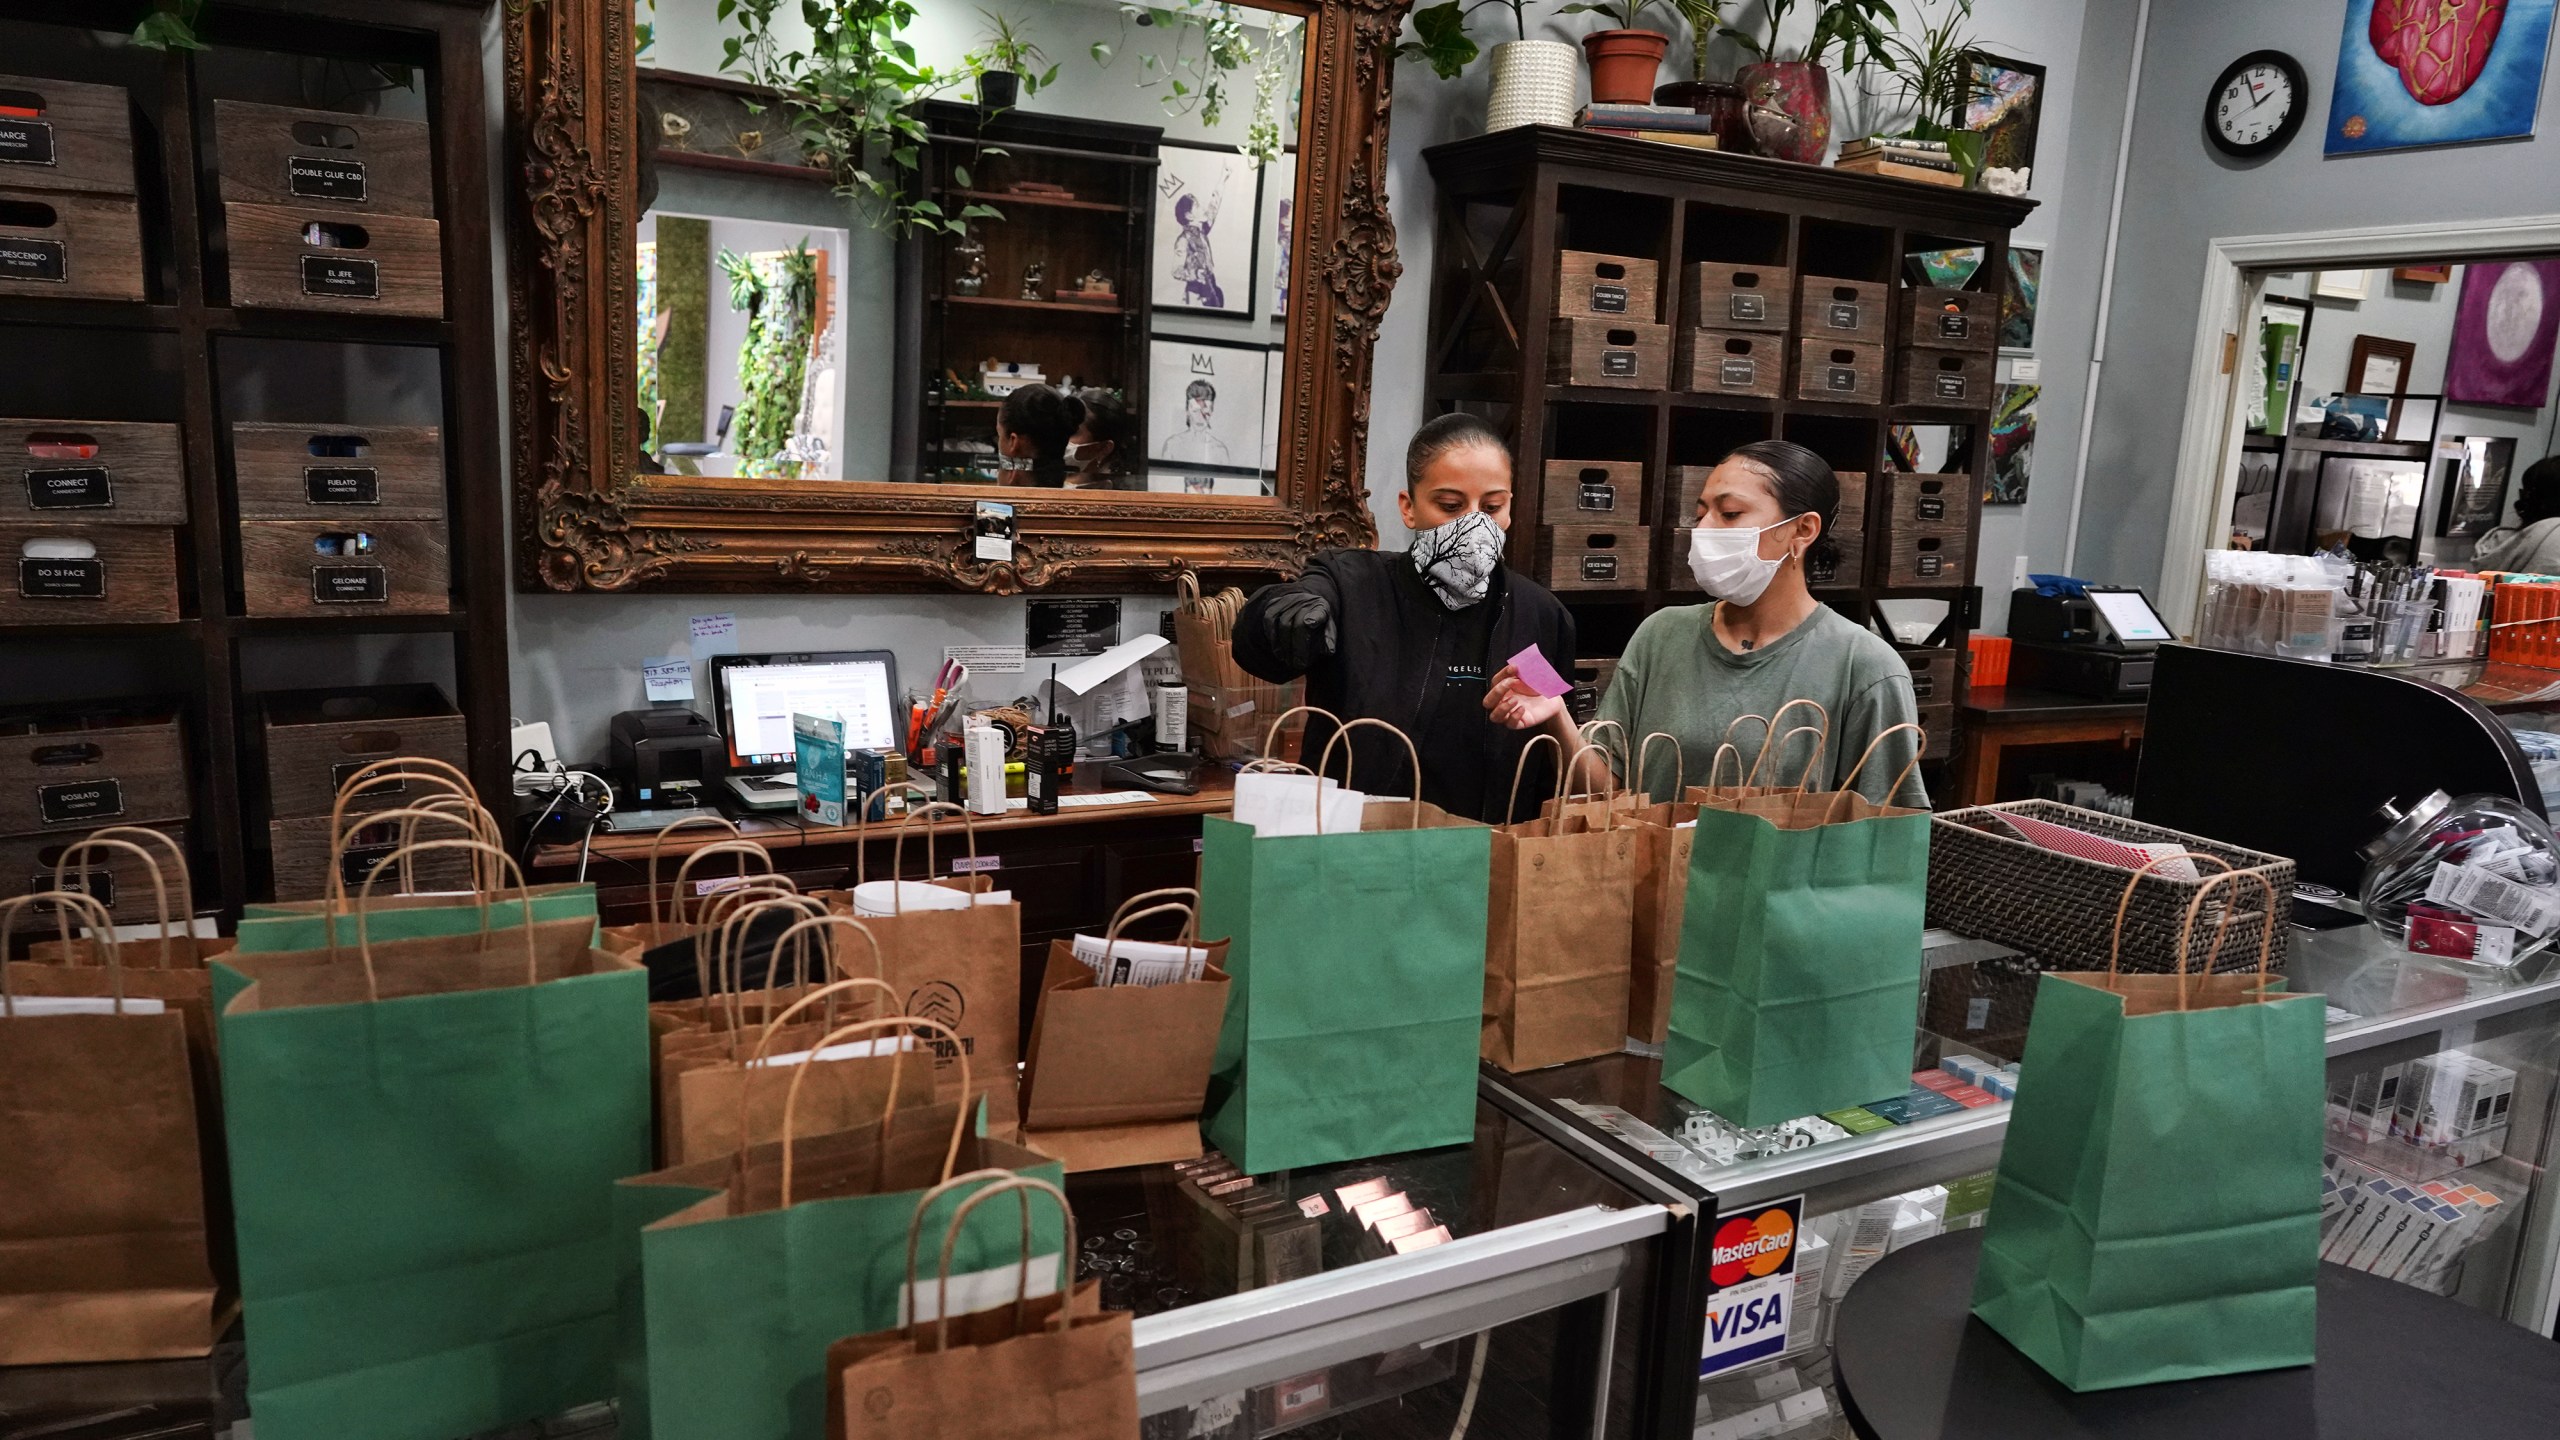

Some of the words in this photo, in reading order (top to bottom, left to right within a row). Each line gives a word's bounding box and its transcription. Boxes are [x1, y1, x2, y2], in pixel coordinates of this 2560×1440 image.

[2254, 66, 2265, 78] 12
[2273, 68, 2279, 79] 1
[2228, 87, 2239, 99] 10
[2220, 105, 2229, 116] 9
[2225, 120, 2233, 131] 8
[2237, 130, 2244, 141] 7
[2250, 131, 2258, 142] 6
[292, 168, 323, 178] DOUBLE
[324, 171, 345, 180] GLUE
[346, 173, 363, 181] CBD
[47, 479, 89, 488] CONNECT
[1144, 679, 1163, 688] ROM
[1711, 1228, 1793, 1266] MasterCard
[1706, 1292, 1782, 1344] VISA
